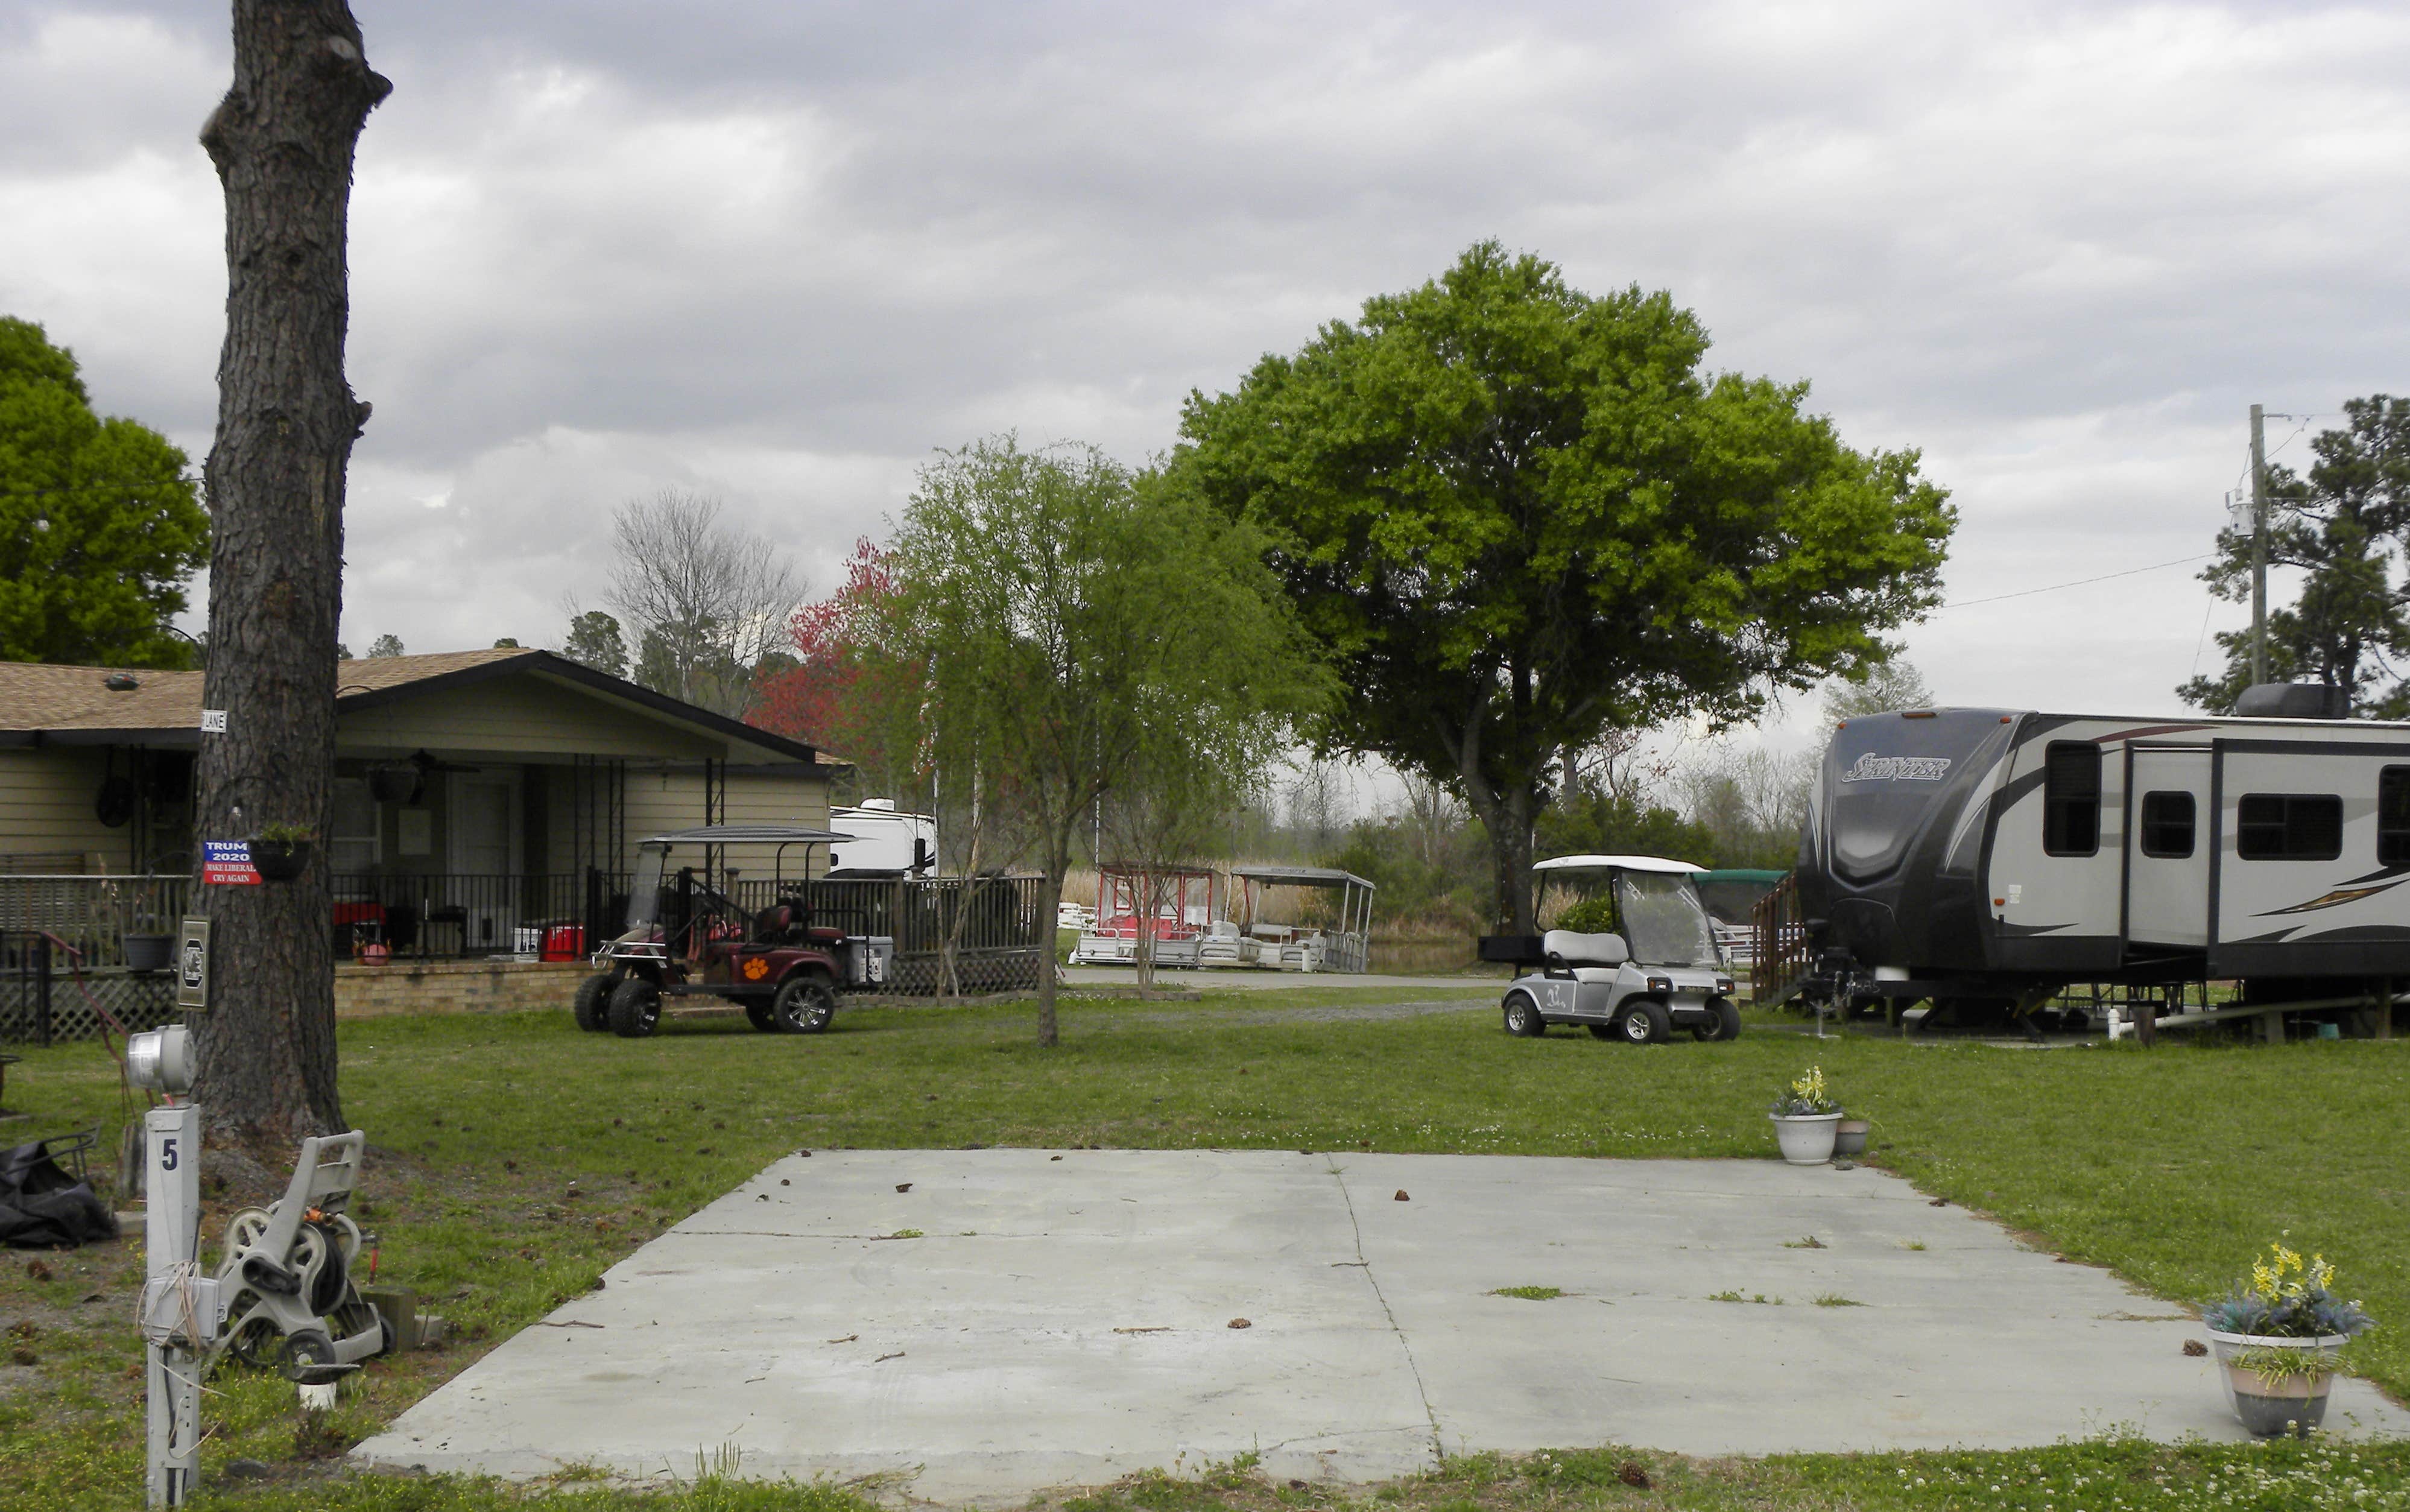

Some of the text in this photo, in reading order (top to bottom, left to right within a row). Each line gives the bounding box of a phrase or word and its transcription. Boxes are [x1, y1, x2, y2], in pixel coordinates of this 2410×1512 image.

[1842, 753, 1951, 782] SPRINTER
[206, 842, 248, 850] TRUM
[213, 853, 250, 861] 2020
[162, 1140, 177, 1171] 5
